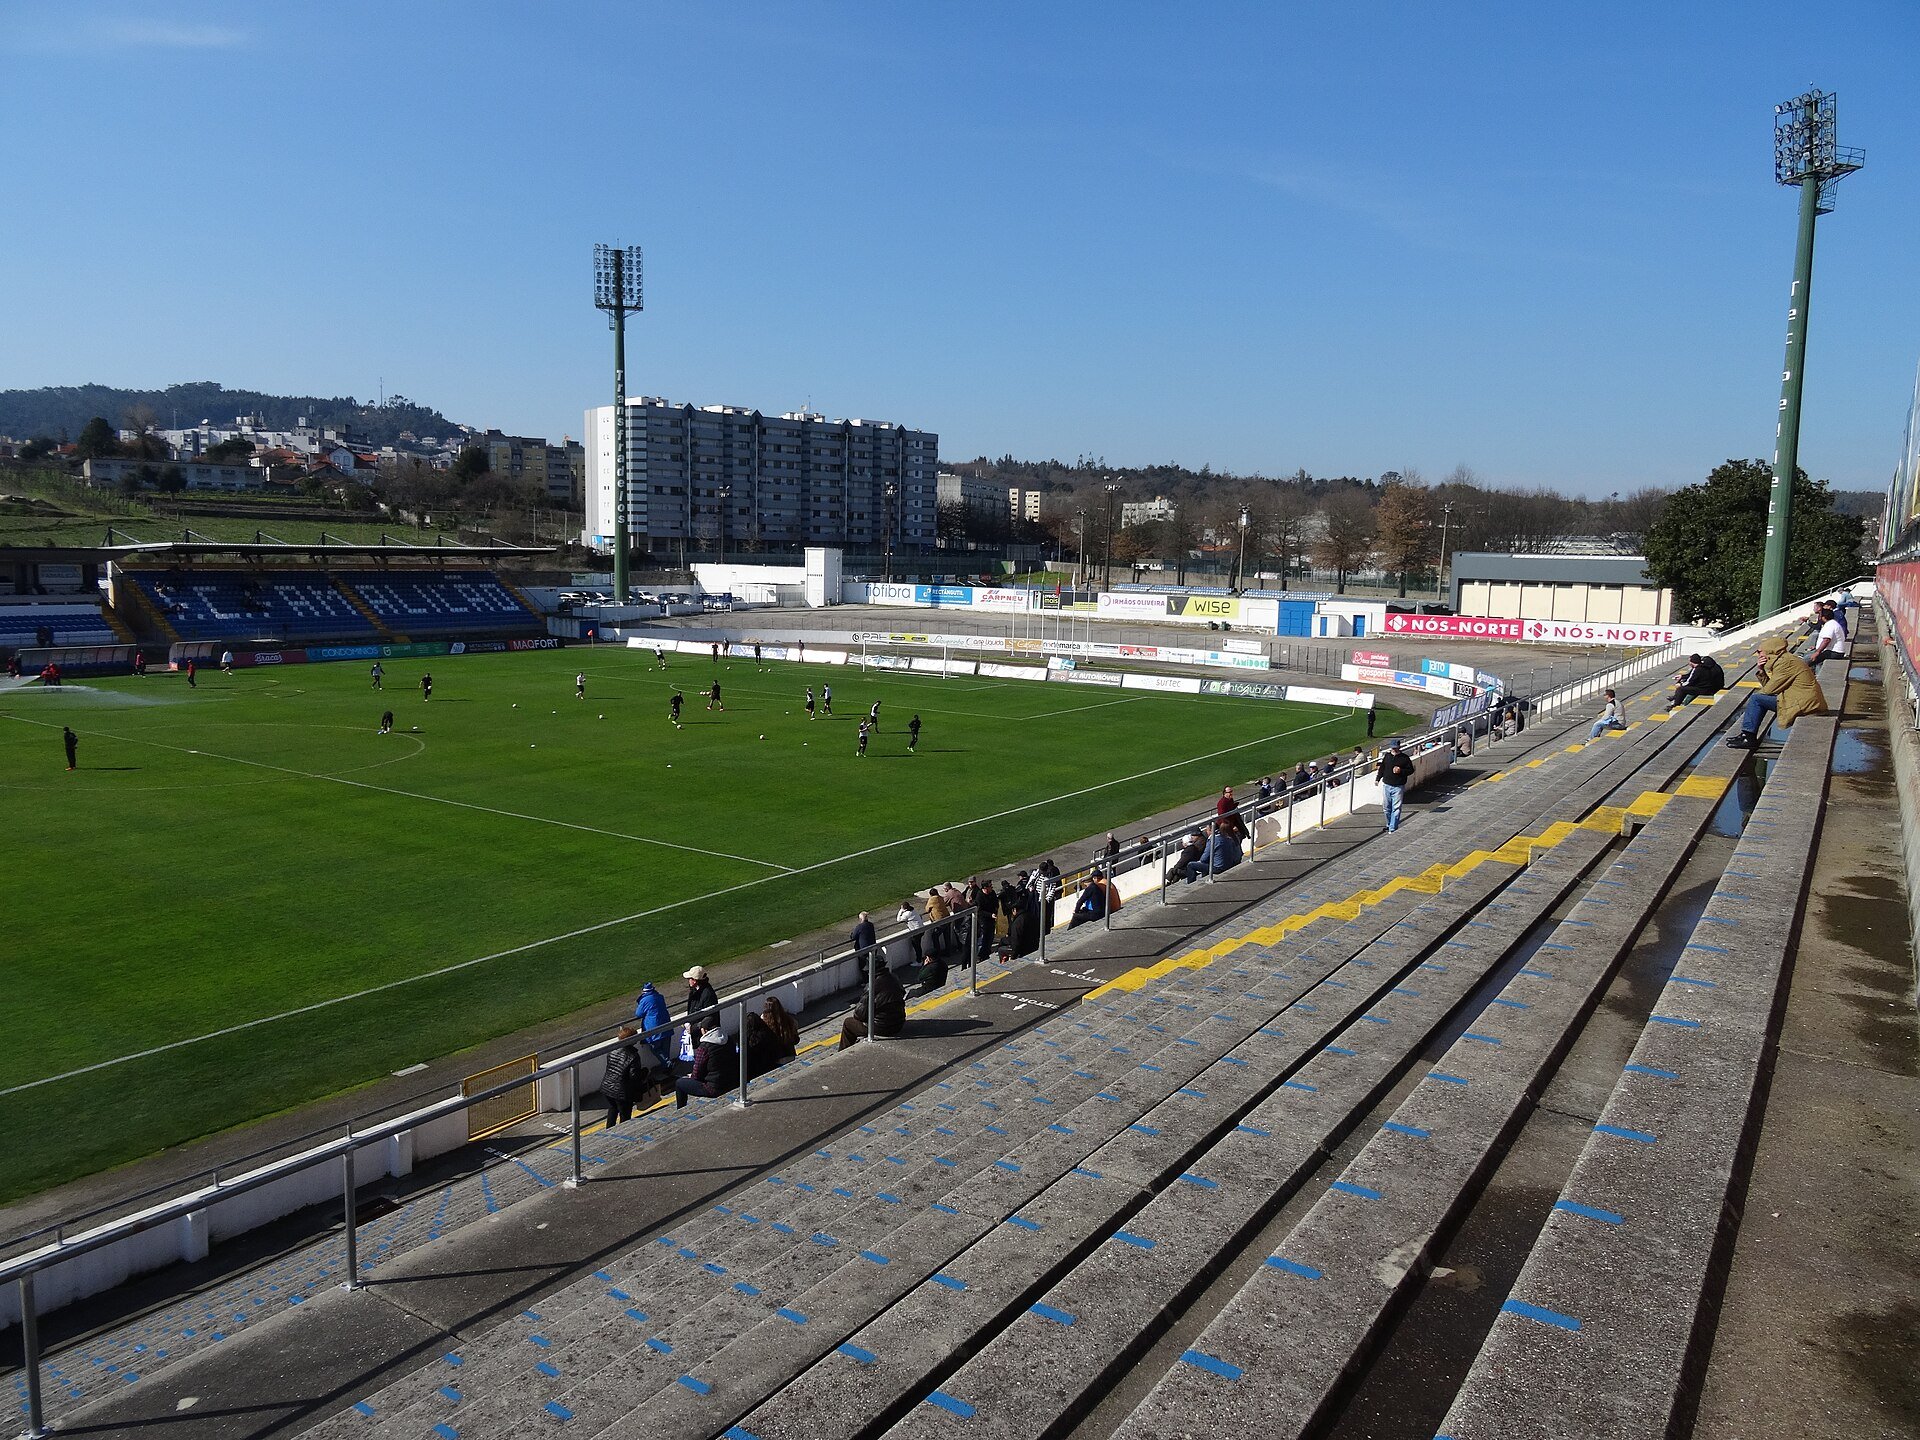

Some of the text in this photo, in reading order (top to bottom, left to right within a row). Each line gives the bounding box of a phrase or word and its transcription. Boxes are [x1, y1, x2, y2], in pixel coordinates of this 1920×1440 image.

[1112, 598, 1166, 608] IRMÃOS OLIVEIRA
[1411, 617, 1519, 636] NÓS-NORTE
[1554, 623, 1673, 643] NÓS-NORTE
[512, 638, 559, 650] MAQFORT
[1155, 678, 1182, 688] surtec
[1067, 972, 1109, 985] SETOR
[1017, 996, 1061, 1010] SETOR
